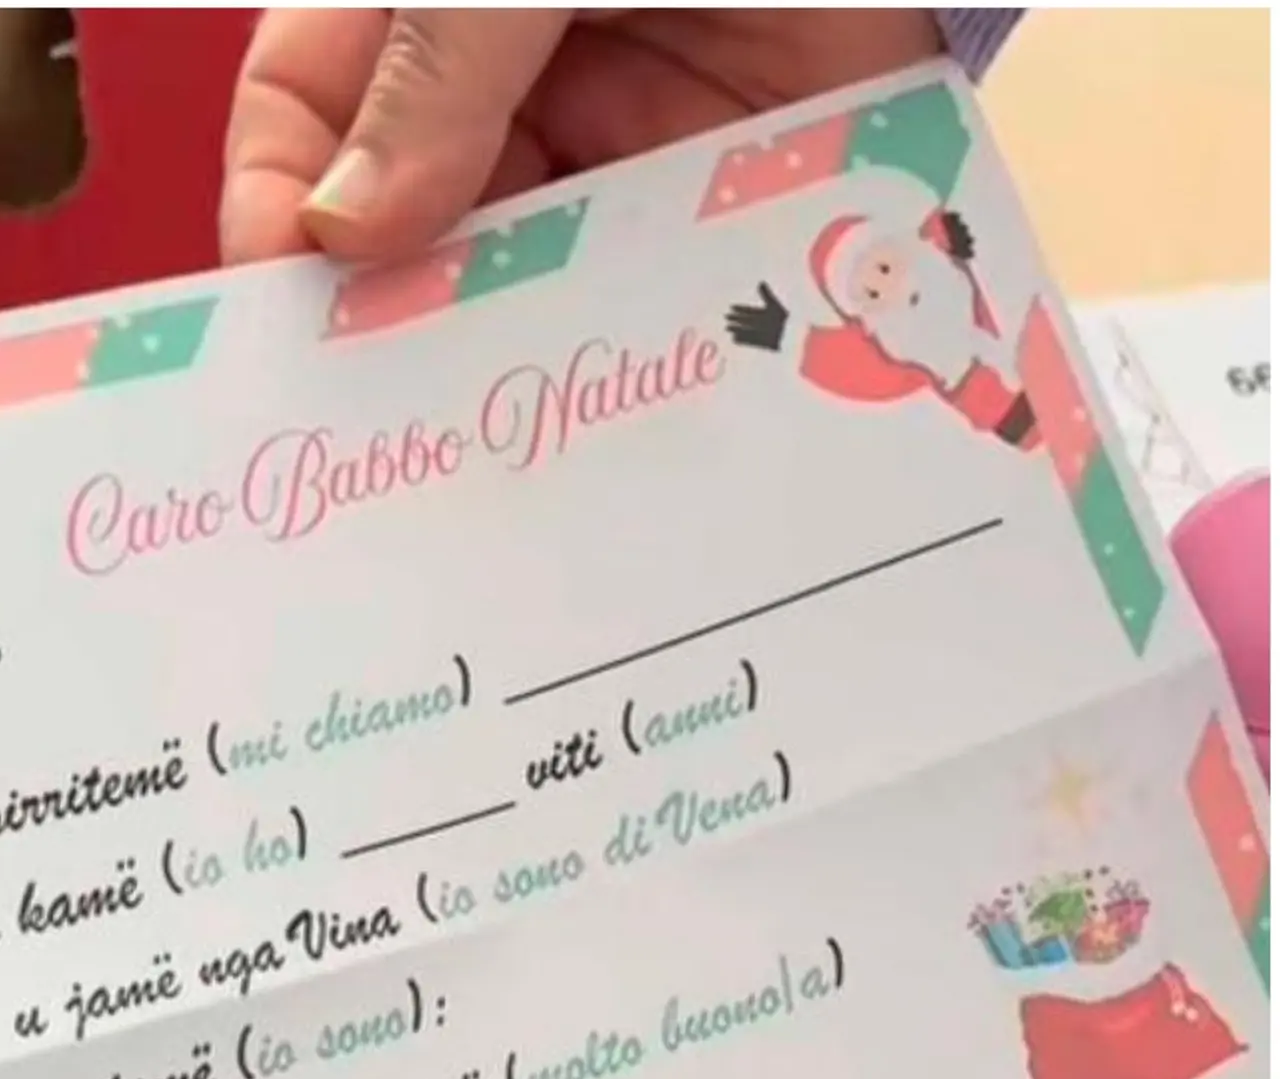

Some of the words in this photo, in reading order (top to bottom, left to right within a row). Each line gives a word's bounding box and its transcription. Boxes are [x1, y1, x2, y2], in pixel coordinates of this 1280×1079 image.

[66, 472, 237, 577] Caro
[242, 418, 473, 544] Babbo
[480, 325, 728, 473] Natale
[18, 860, 144, 936] kamë
[161, 838, 224, 895] (io
[244, 806, 308, 871] ho)
[525, 730, 604, 790] viti
[622, 660, 759, 756] (anni)
[206, 722, 289, 776] (mi
[304, 654, 473, 753] chiamo)
[13, 1007, 48, 1038] u
[65, 953, 183, 1041] jamë
[416, 872, 477, 924] (io
[493, 838, 585, 904] sono
[315, 976, 448, 1061] sono):
